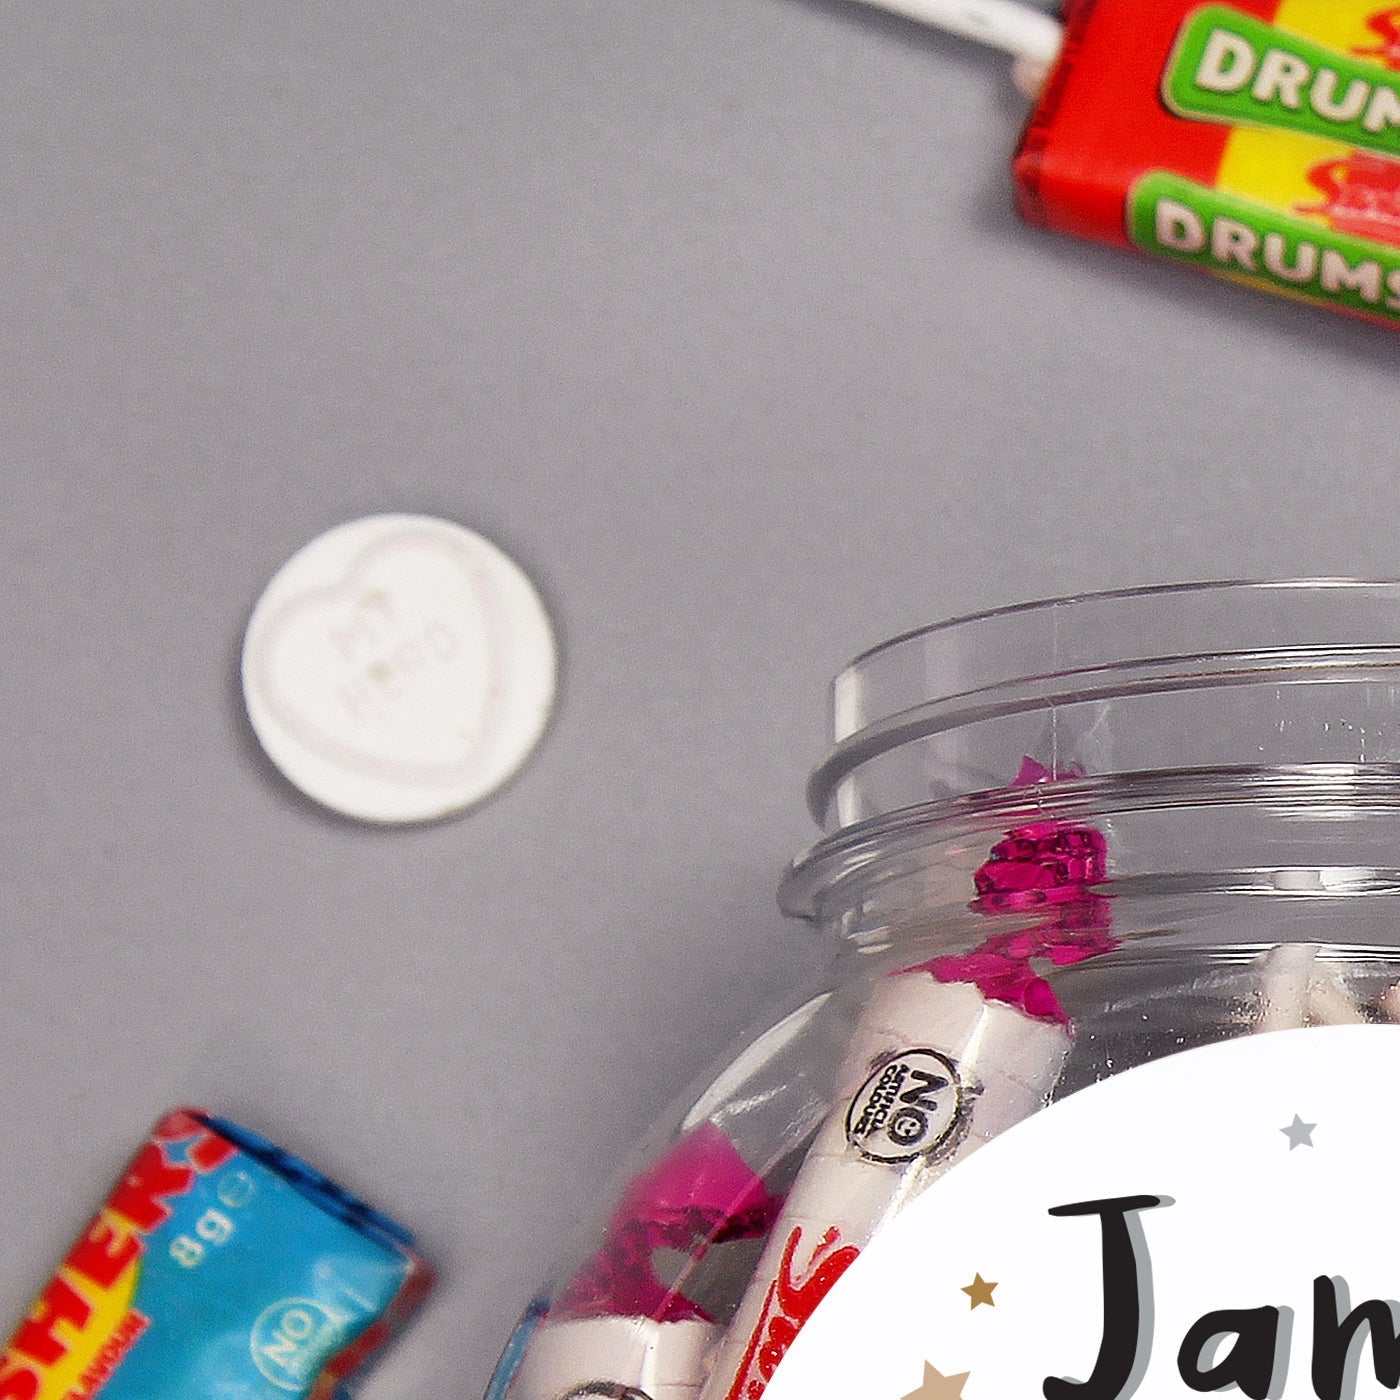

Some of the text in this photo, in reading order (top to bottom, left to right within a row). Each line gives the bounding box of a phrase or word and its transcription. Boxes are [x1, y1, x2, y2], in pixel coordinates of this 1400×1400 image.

[887, 1069, 949, 1146] NO
[169, 1207, 234, 1269] 8g
[263, 1308, 313, 1368] NO
